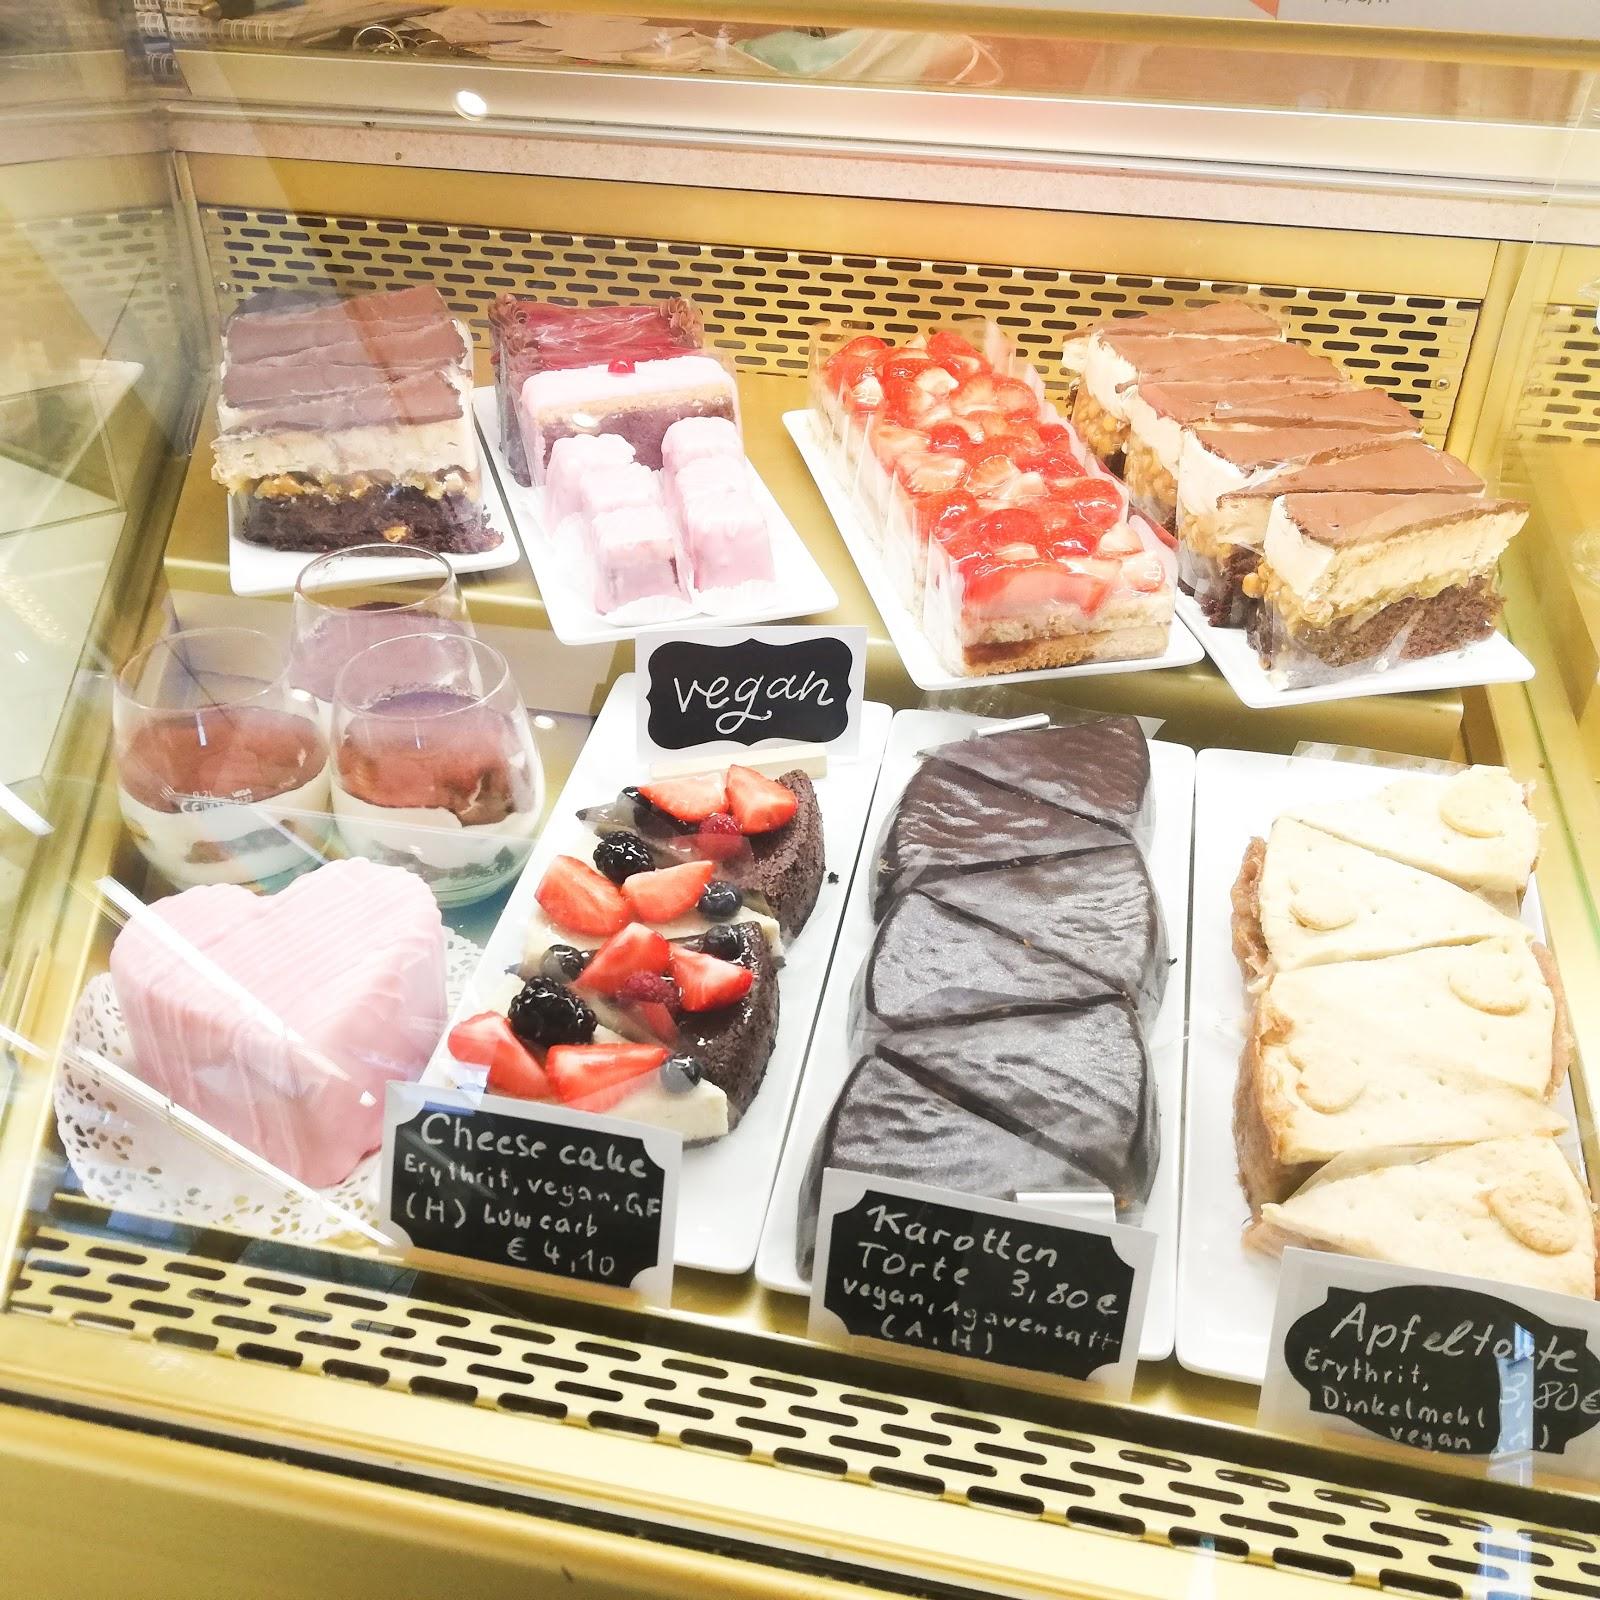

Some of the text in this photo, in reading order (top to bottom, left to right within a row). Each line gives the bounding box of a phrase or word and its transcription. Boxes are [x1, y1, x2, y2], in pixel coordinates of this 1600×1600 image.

[673, 670, 834, 734] vegan
[421, 1112, 647, 1178] Cheese cake
[404, 1153, 519, 1196] Erythrit,
[406, 1192, 466, 1229] (H)
[544, 1240, 615, 1276] 4,10
[866, 1204, 1058, 1268] Karotten
[1330, 1302, 1578, 1373] Apfeltote
[1304, 1347, 1430, 1392] Erythrit,
[1389, 1425, 1472, 1451] vegan
